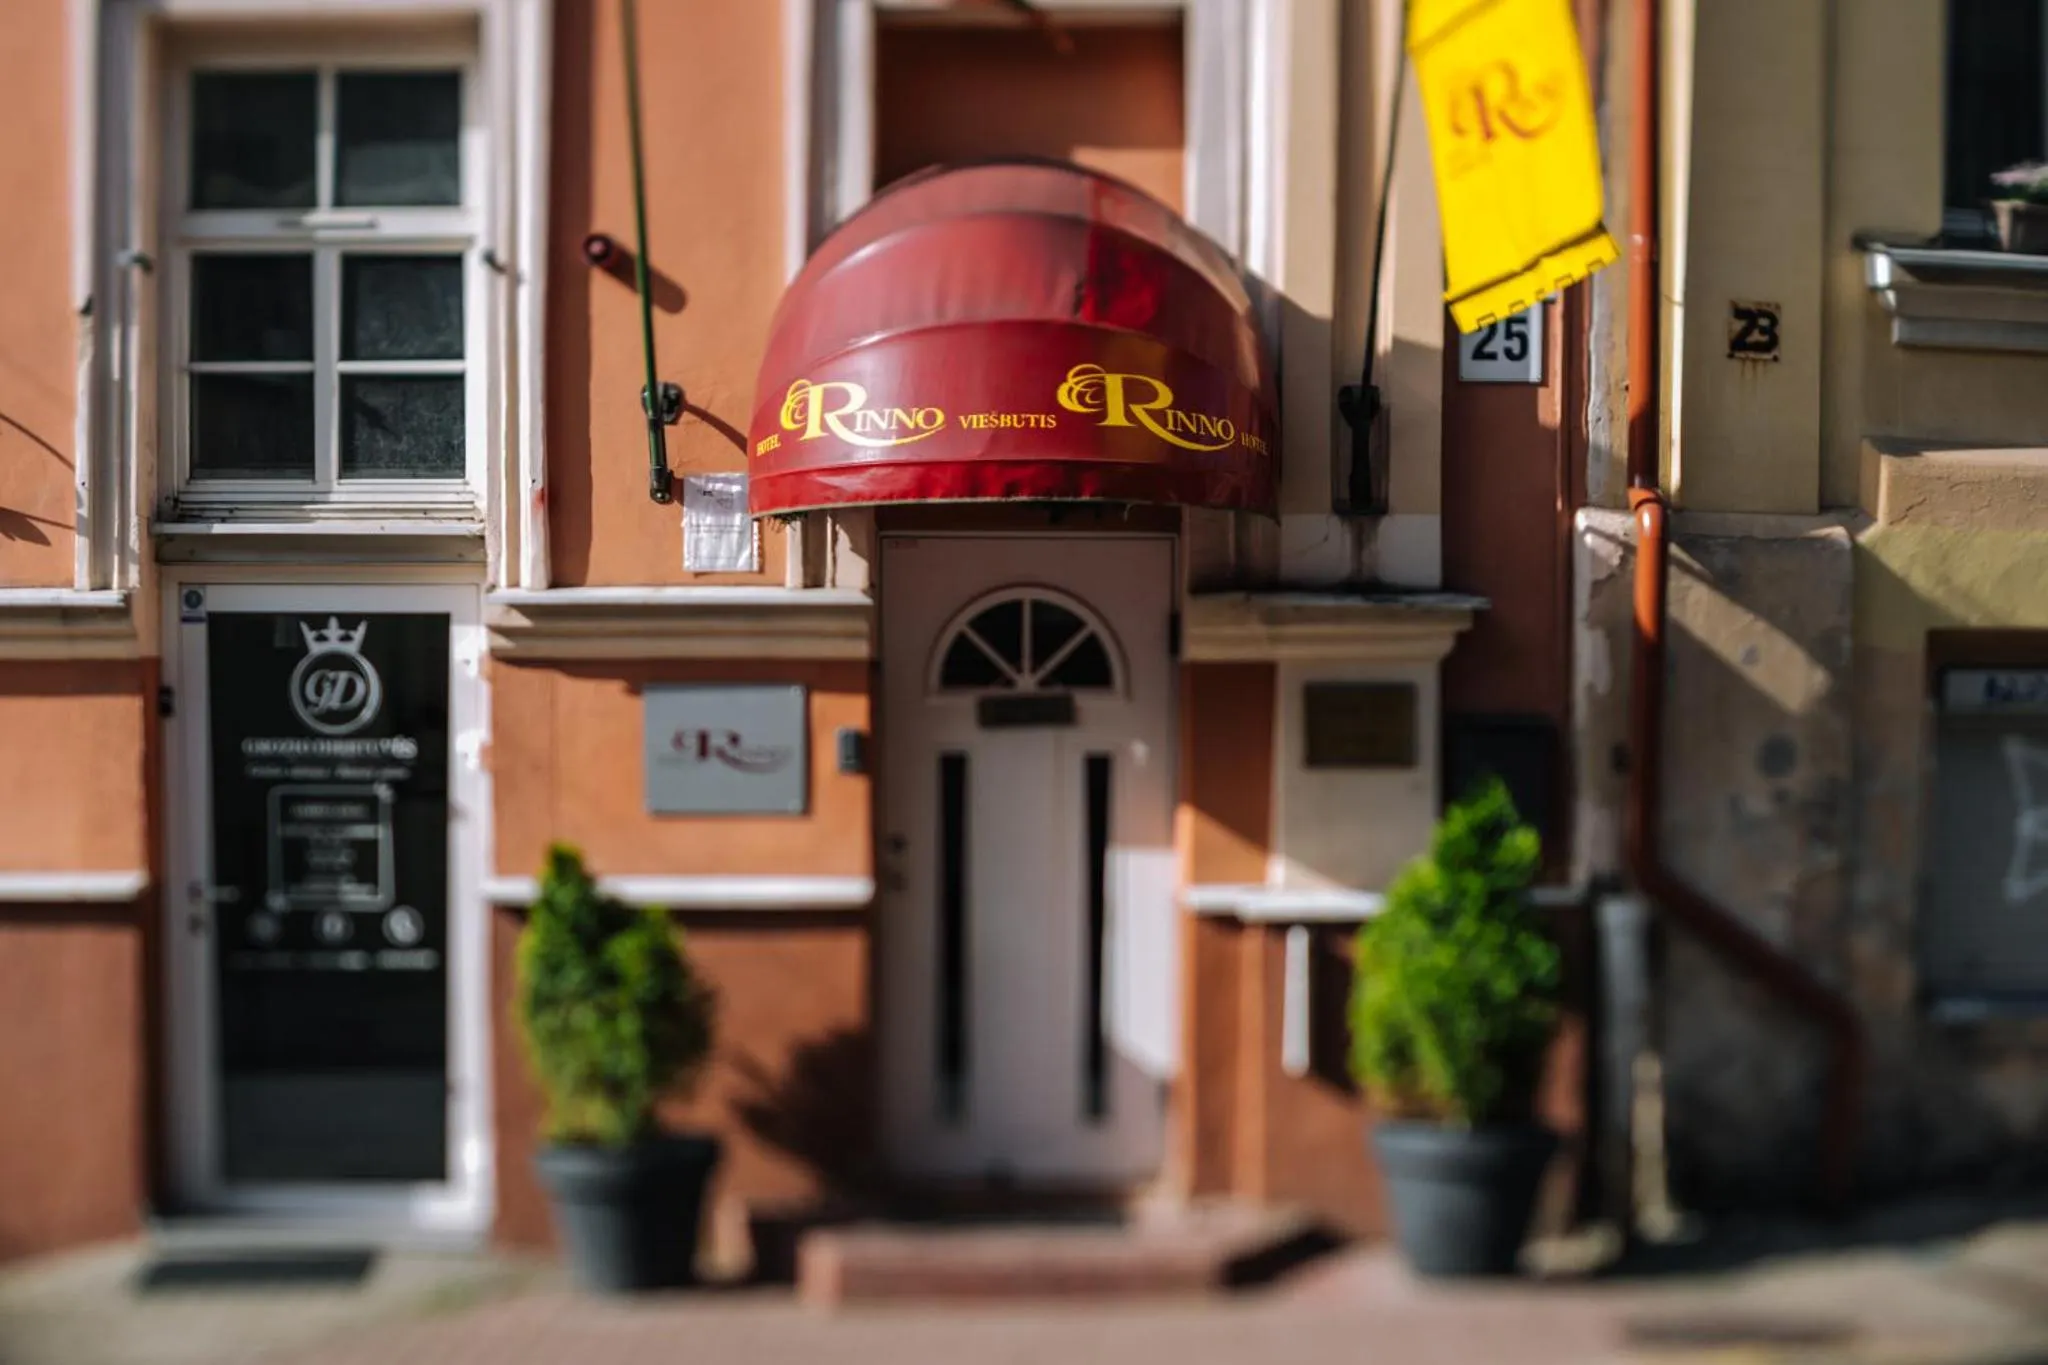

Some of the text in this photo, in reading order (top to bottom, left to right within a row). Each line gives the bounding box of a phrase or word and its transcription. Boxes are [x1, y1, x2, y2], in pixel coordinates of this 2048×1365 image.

[1471, 315, 1529, 361] 25
[756, 433, 782, 457] HOTEL
[780, 379, 946, 447] RINNO
[958, 410, 1057, 429] VIEŠBUTIS
[1057, 363, 1236, 451] RINNO
